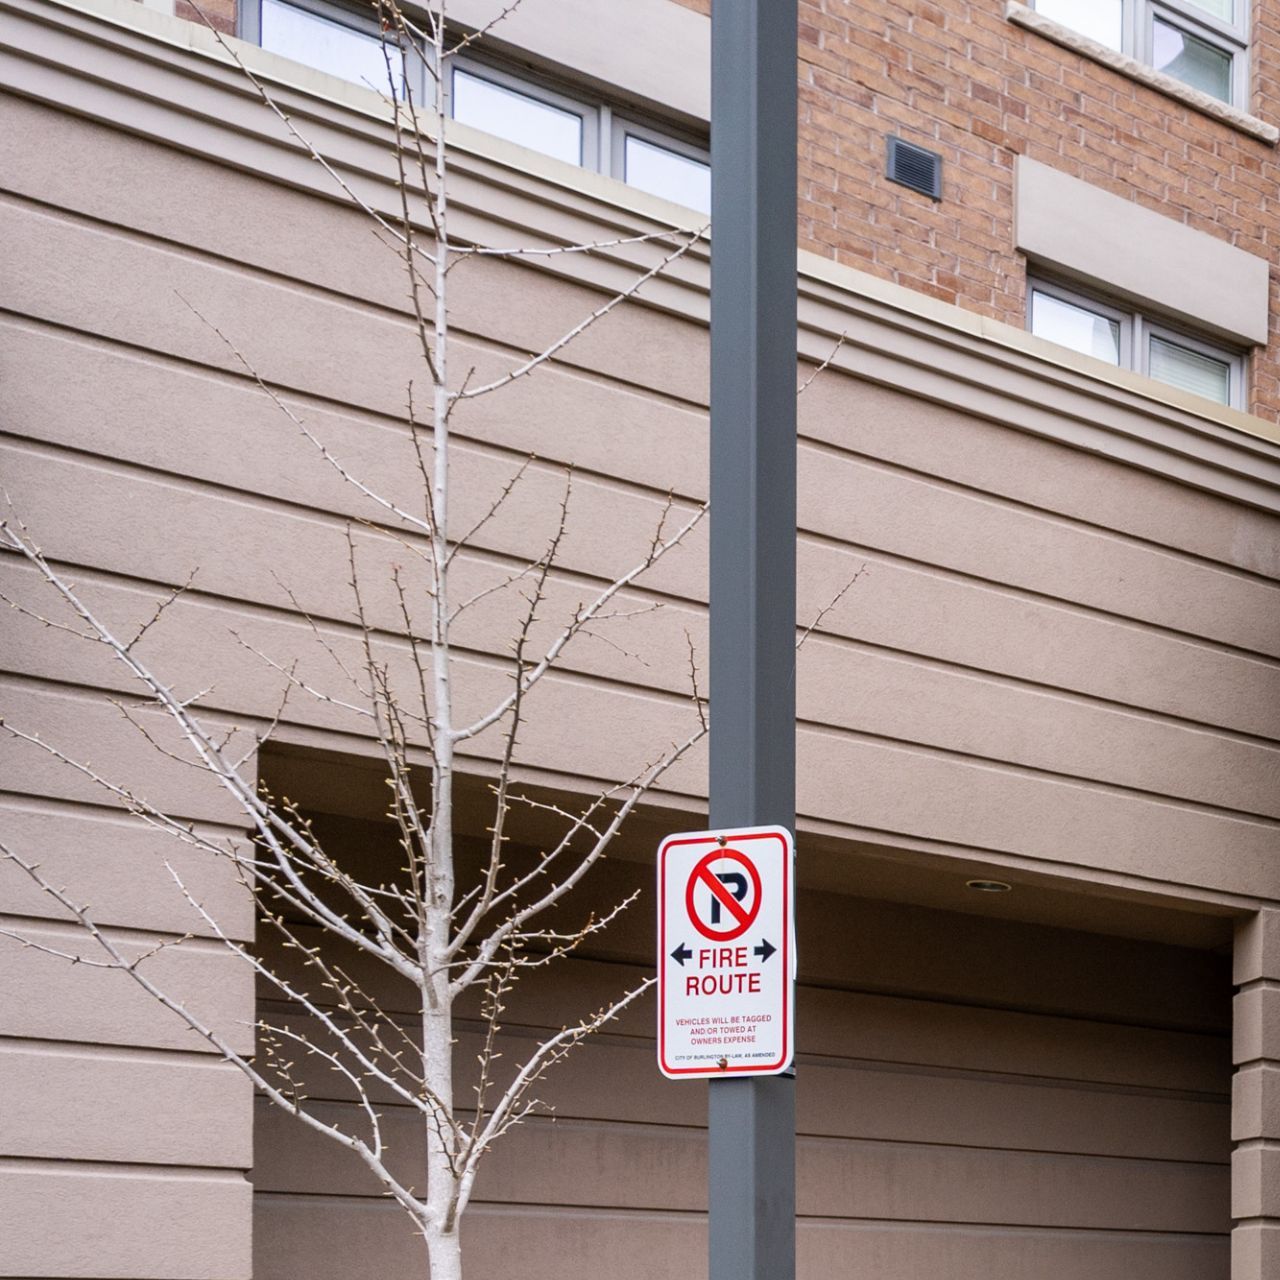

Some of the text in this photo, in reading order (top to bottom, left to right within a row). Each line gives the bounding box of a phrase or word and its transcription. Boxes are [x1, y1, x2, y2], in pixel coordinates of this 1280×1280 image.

[699, 947, 748, 969] FIRE
[686, 973, 761, 996] ROUTE
[675, 1014, 772, 1026] VEHICLES WILL BE TAGGED
[719, 1025, 746, 1034] TOWED
[747, 1025, 757, 1033] AT
[690, 1035, 757, 1045] OWNERS EXPENSE
